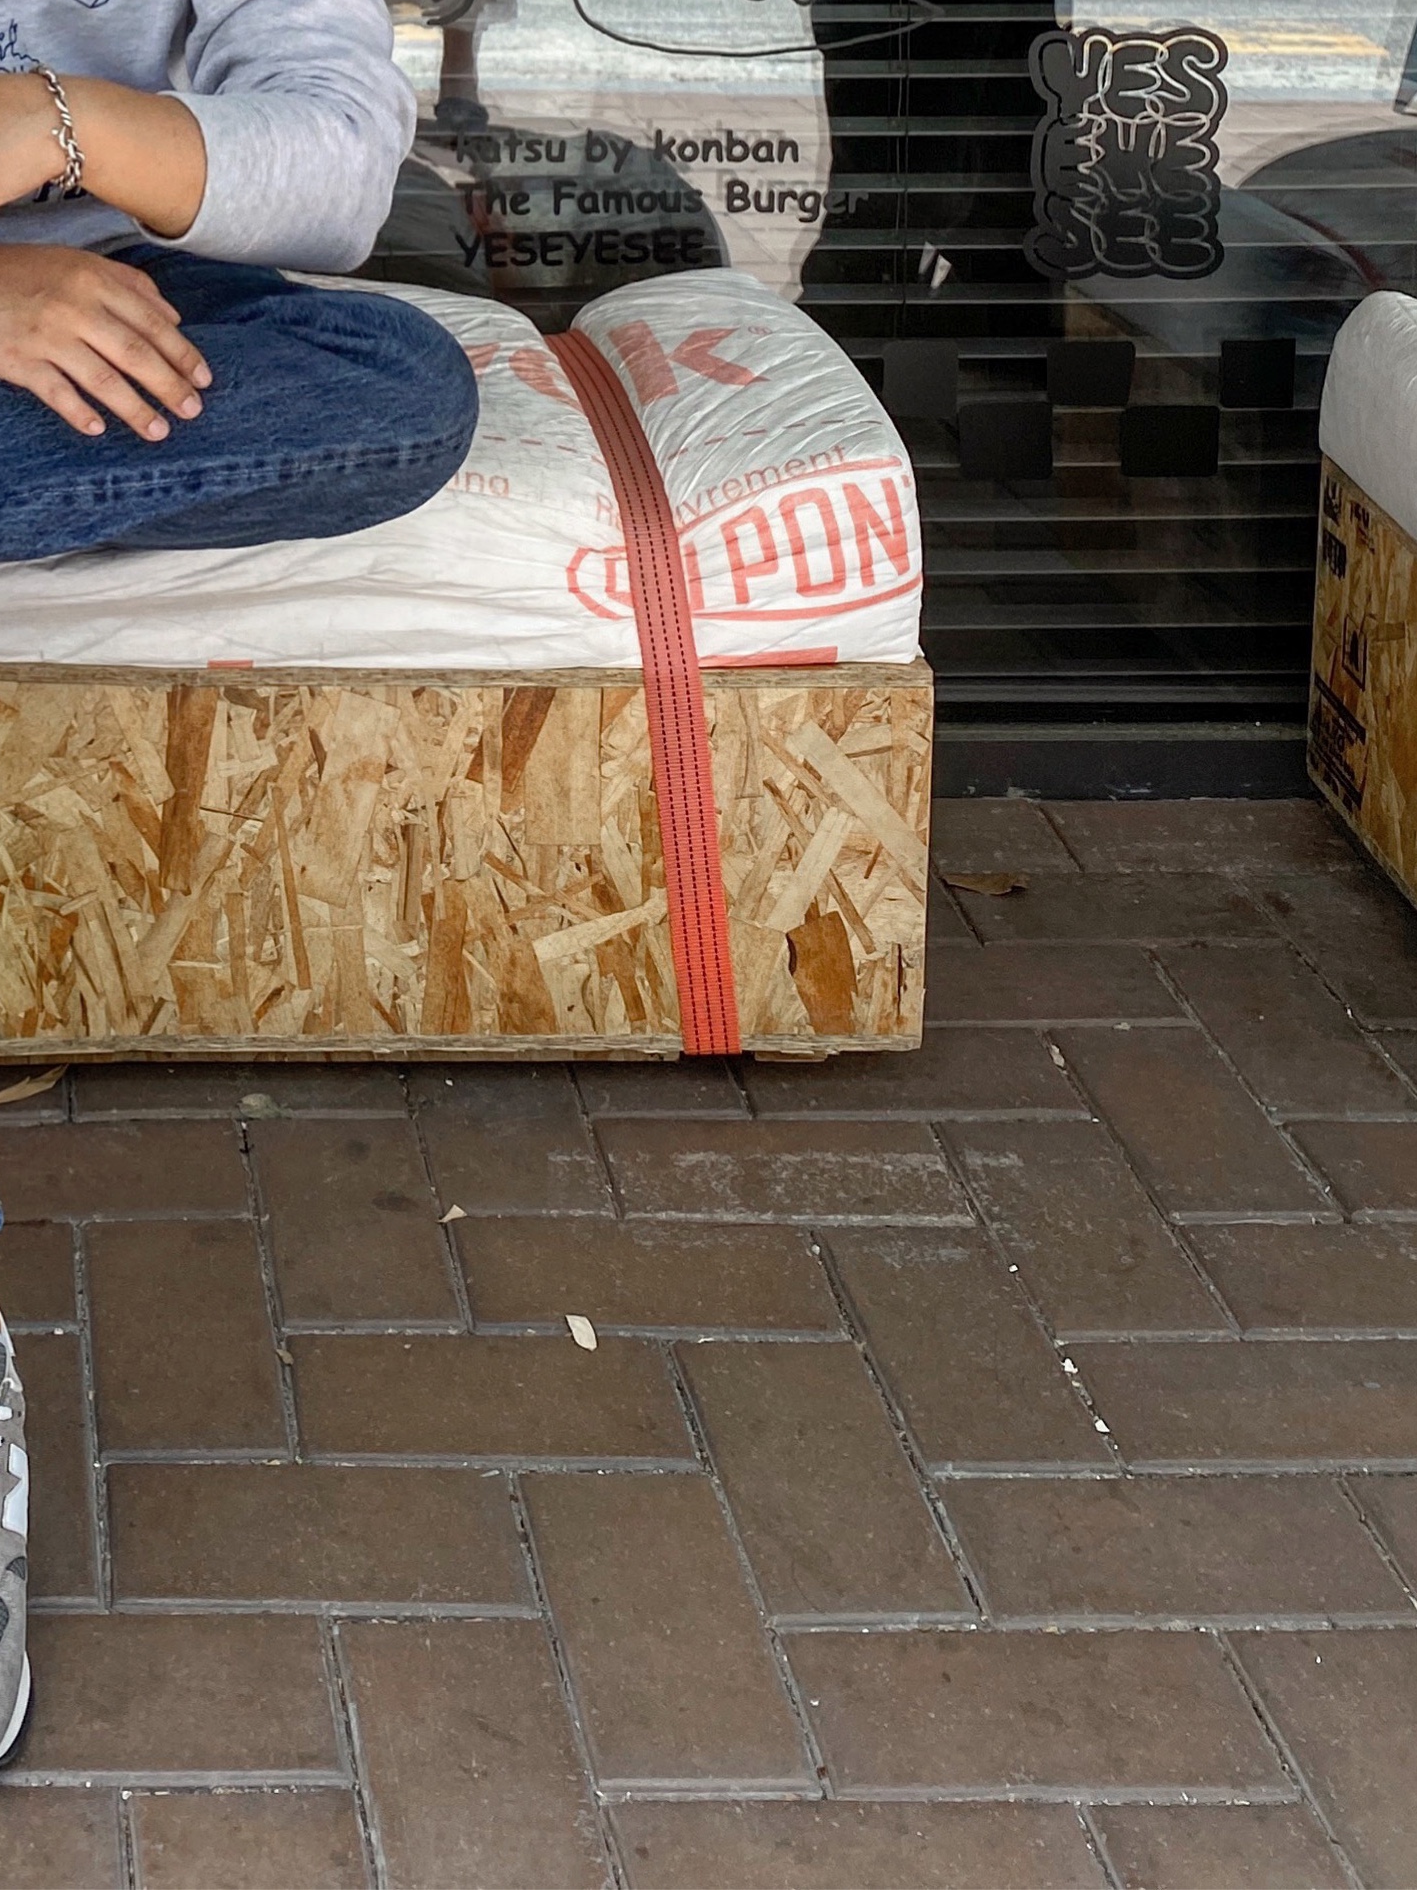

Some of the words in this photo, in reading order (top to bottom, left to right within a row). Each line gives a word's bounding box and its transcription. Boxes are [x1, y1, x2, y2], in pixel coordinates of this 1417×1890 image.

[585, 128, 633, 173] by
[652, 126, 800, 165] konban
[456, 182, 532, 217] The
[552, 181, 704, 216] Famous
[725, 179, 869, 223] Burger
[452, 226, 706, 268] YESEYESEE
